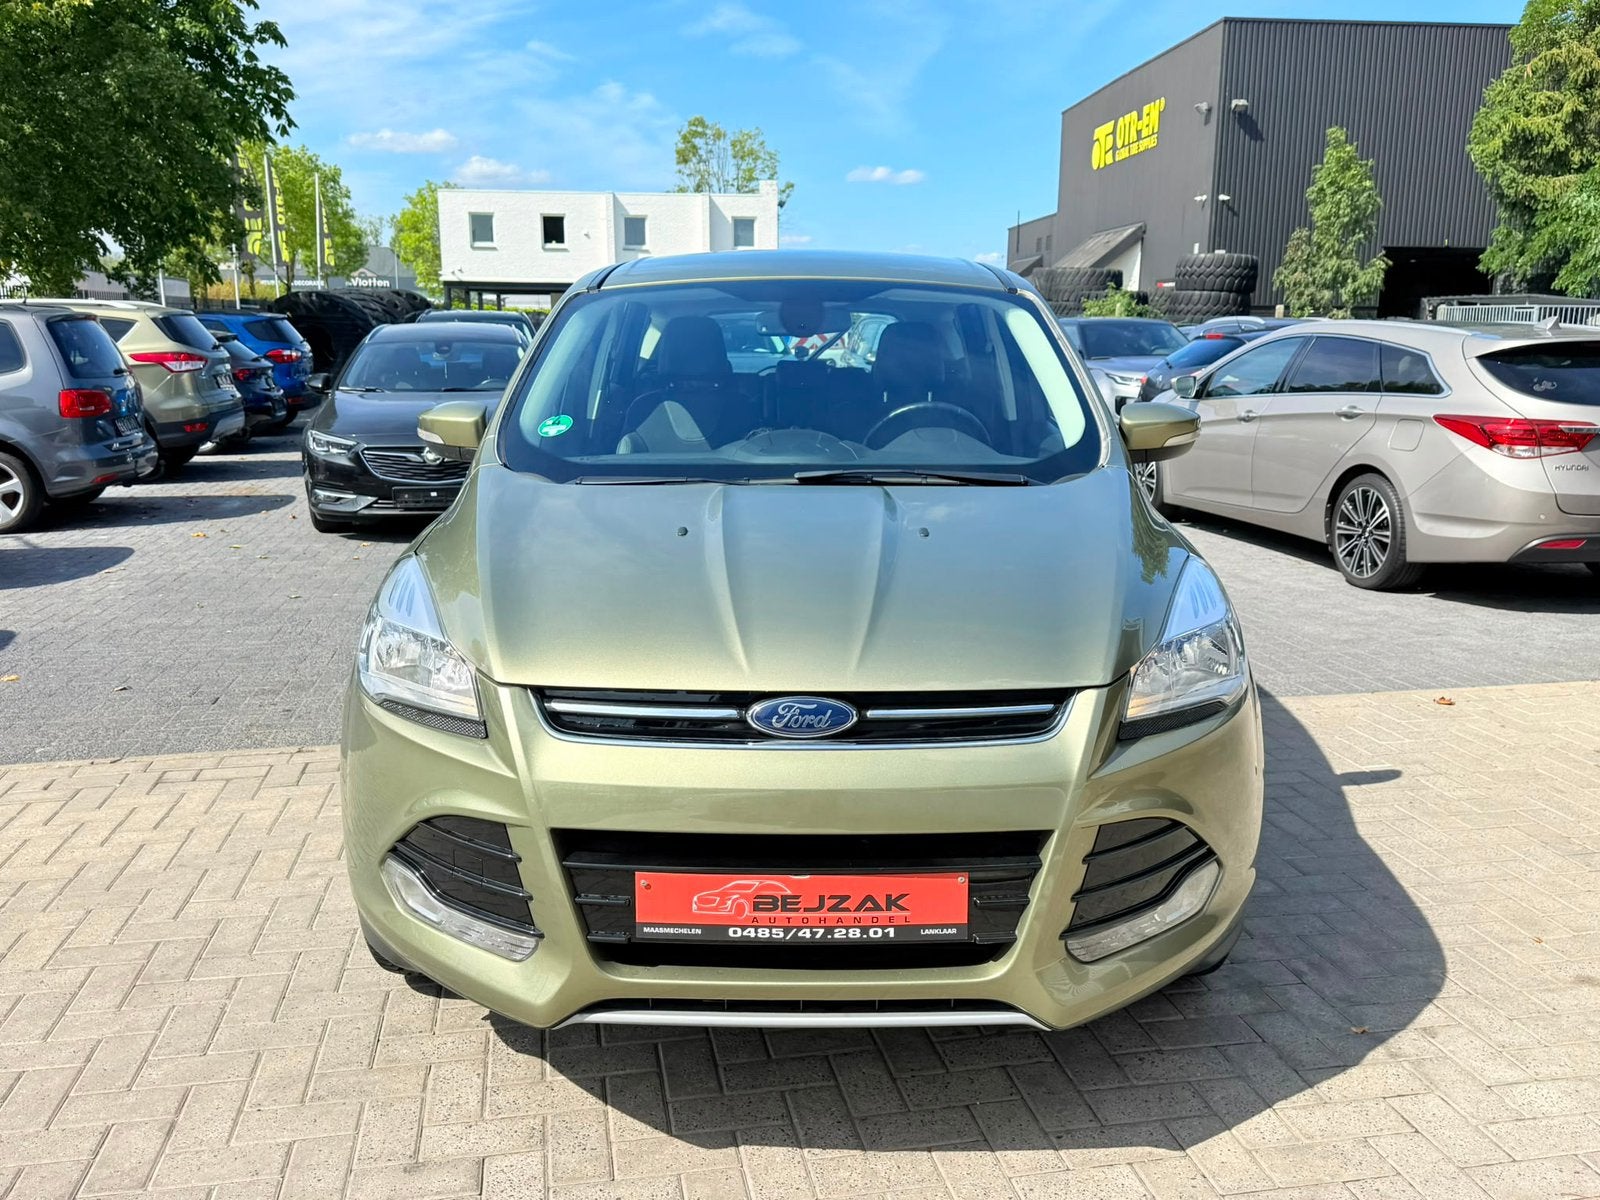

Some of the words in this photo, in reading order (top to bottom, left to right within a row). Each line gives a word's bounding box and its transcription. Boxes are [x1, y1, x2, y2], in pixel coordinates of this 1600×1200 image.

[1554, 464, 1590, 472] HYUNDAI
[771, 702, 833, 728] Ford
[752, 893, 911, 913] BEJZAK
[751, 916, 911, 924] AUTOHANDEL
[643, 926, 702, 935] MAASMECHELEN
[728, 927, 895, 940] 0485/47.28.01
[920, 927, 957, 935] LANKLAAR
